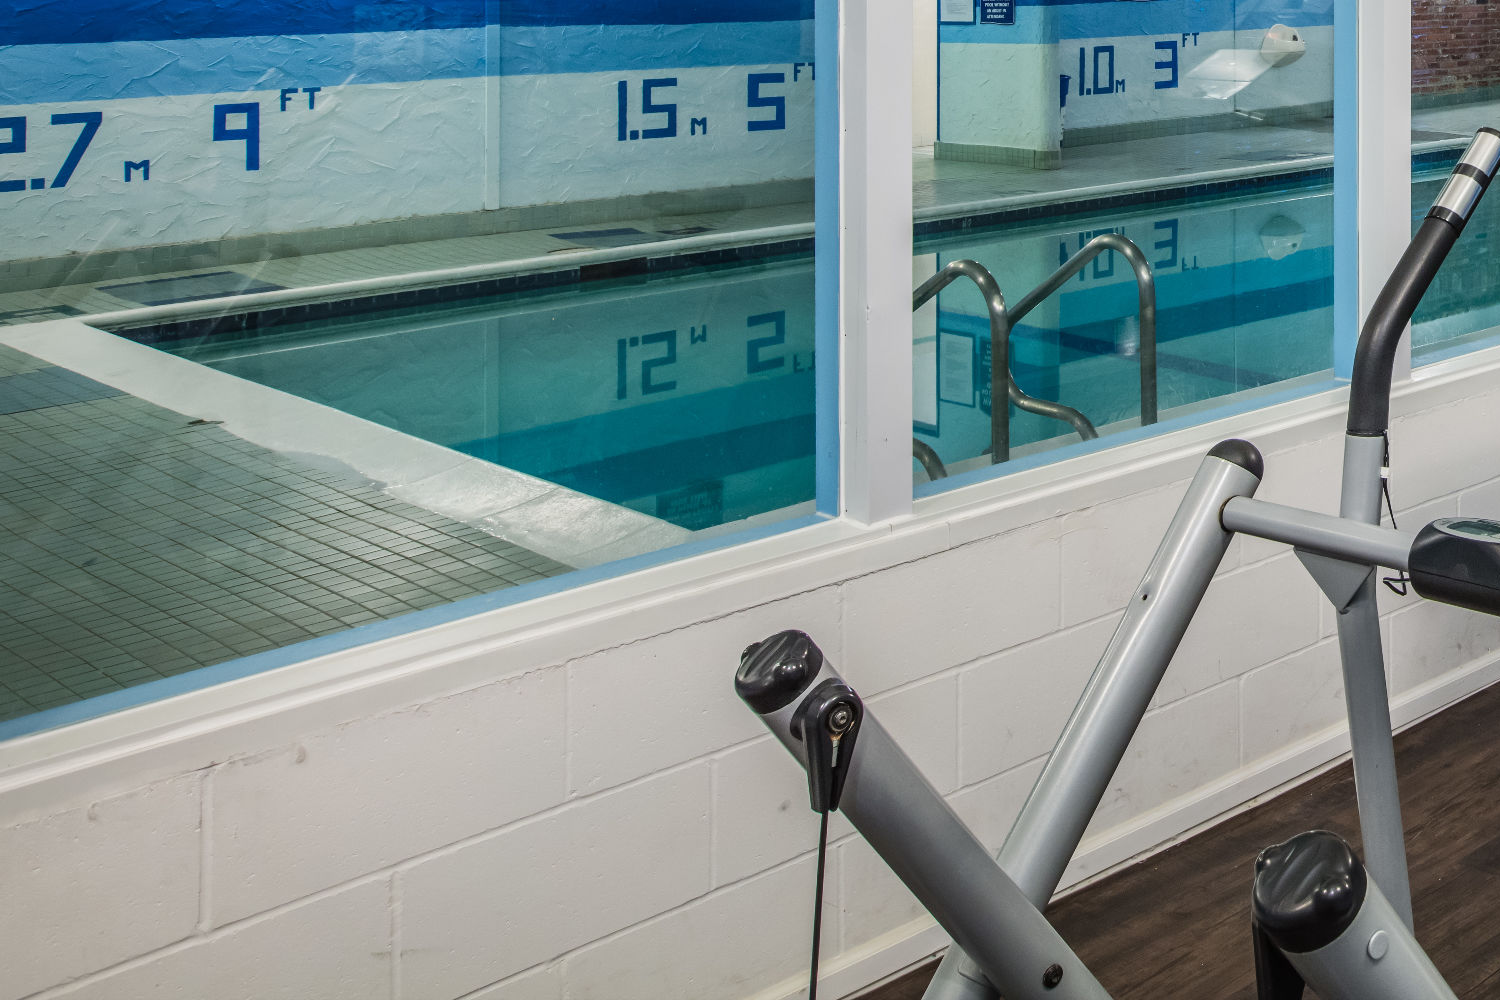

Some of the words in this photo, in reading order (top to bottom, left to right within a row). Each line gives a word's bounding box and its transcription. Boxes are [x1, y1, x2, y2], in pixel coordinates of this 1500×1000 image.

[1079, 45, 1115, 96] 1.0
[1115, 79, 1126, 93] M
[1154, 41, 1178, 89] 3
[1182, 32, 1200, 47] FT
[213, 102, 260, 171] 9
[280, 87, 321, 112] FT
[618, 78, 677, 141] 1.5
[690, 117, 707, 136] M
[747, 73, 786, 131] 5
[124, 160, 150, 182] M
